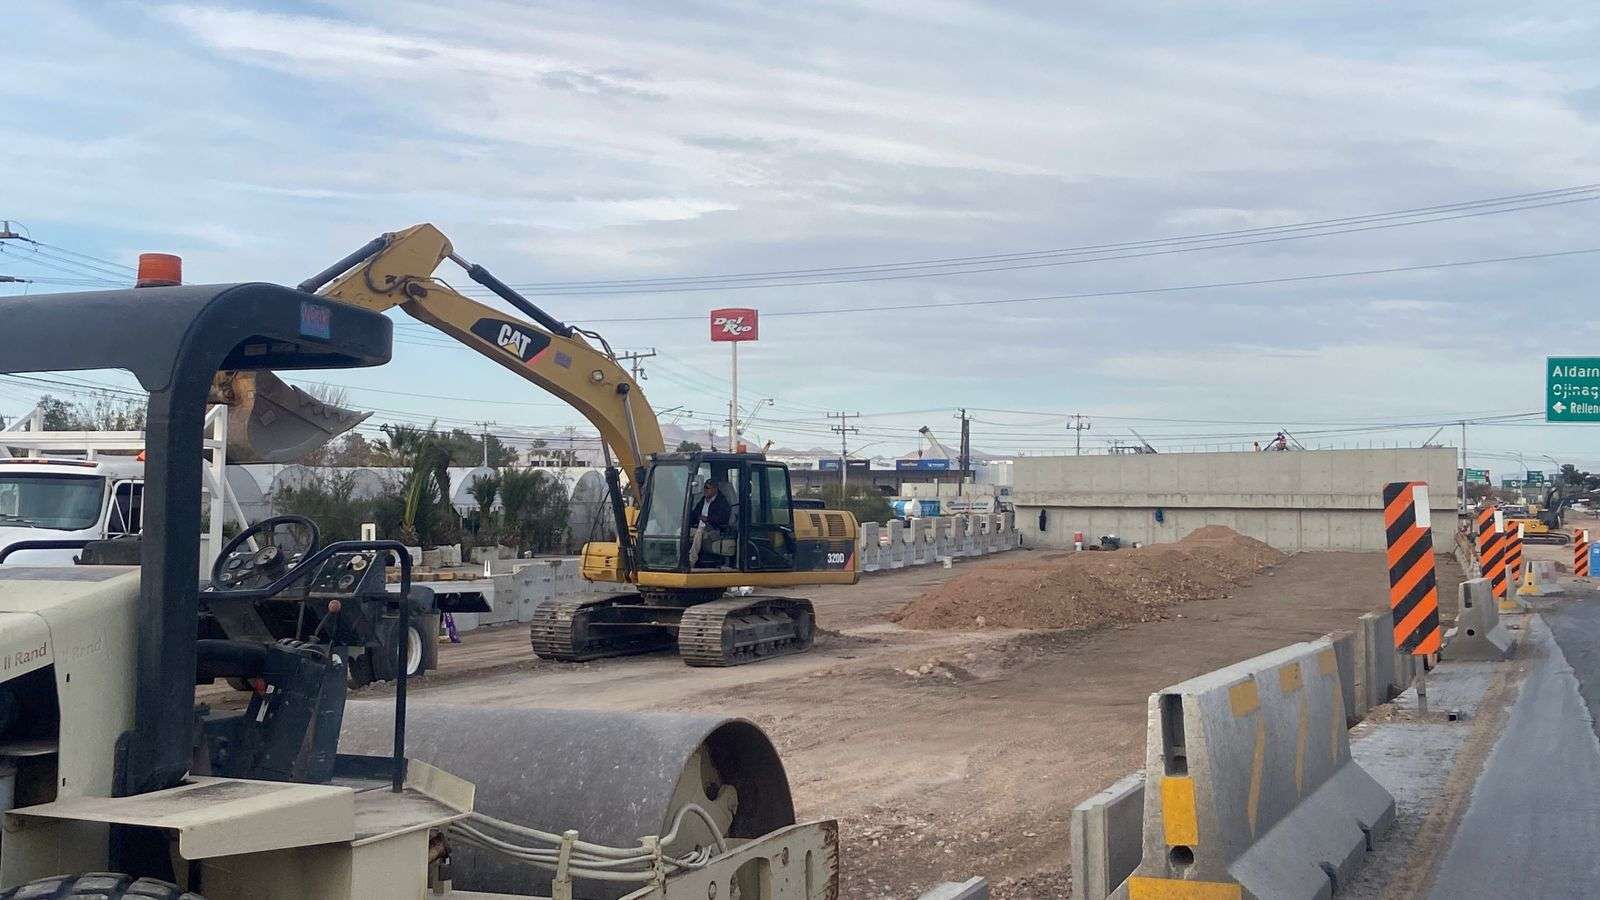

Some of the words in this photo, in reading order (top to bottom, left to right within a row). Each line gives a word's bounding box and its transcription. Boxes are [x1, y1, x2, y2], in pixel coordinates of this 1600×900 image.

[496, 323, 532, 359] CAT
[1552, 384, 1600, 399] Ojinag
[1570, 401, 1600, 414] Rellen
[827, 552, 845, 564] 320D
[14, 641, 47, 667] Rand
